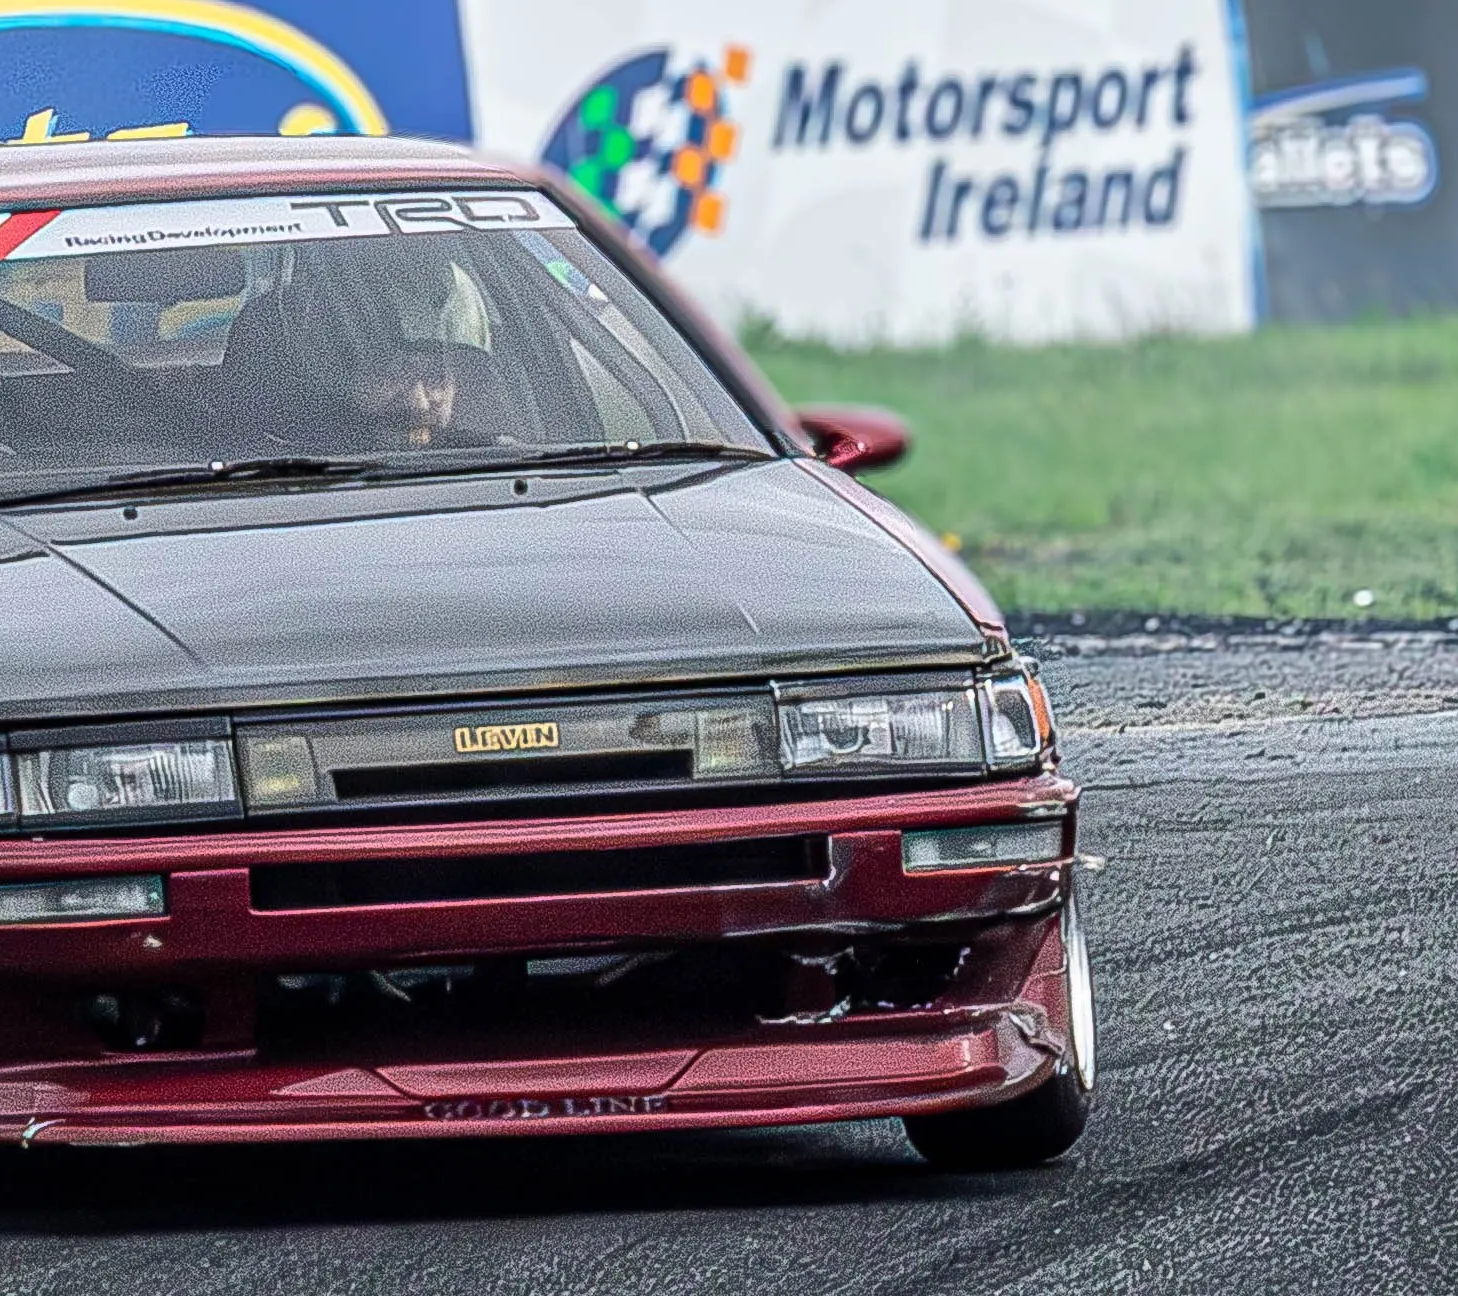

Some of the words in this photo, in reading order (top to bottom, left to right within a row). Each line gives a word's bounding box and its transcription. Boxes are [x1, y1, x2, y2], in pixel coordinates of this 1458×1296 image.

[770, 45, 1197, 159] Motorsport
[918, 149, 1185, 242] Ireland
[1250, 116, 1429, 194] allets
[455, 722, 559, 752] LEVIN
